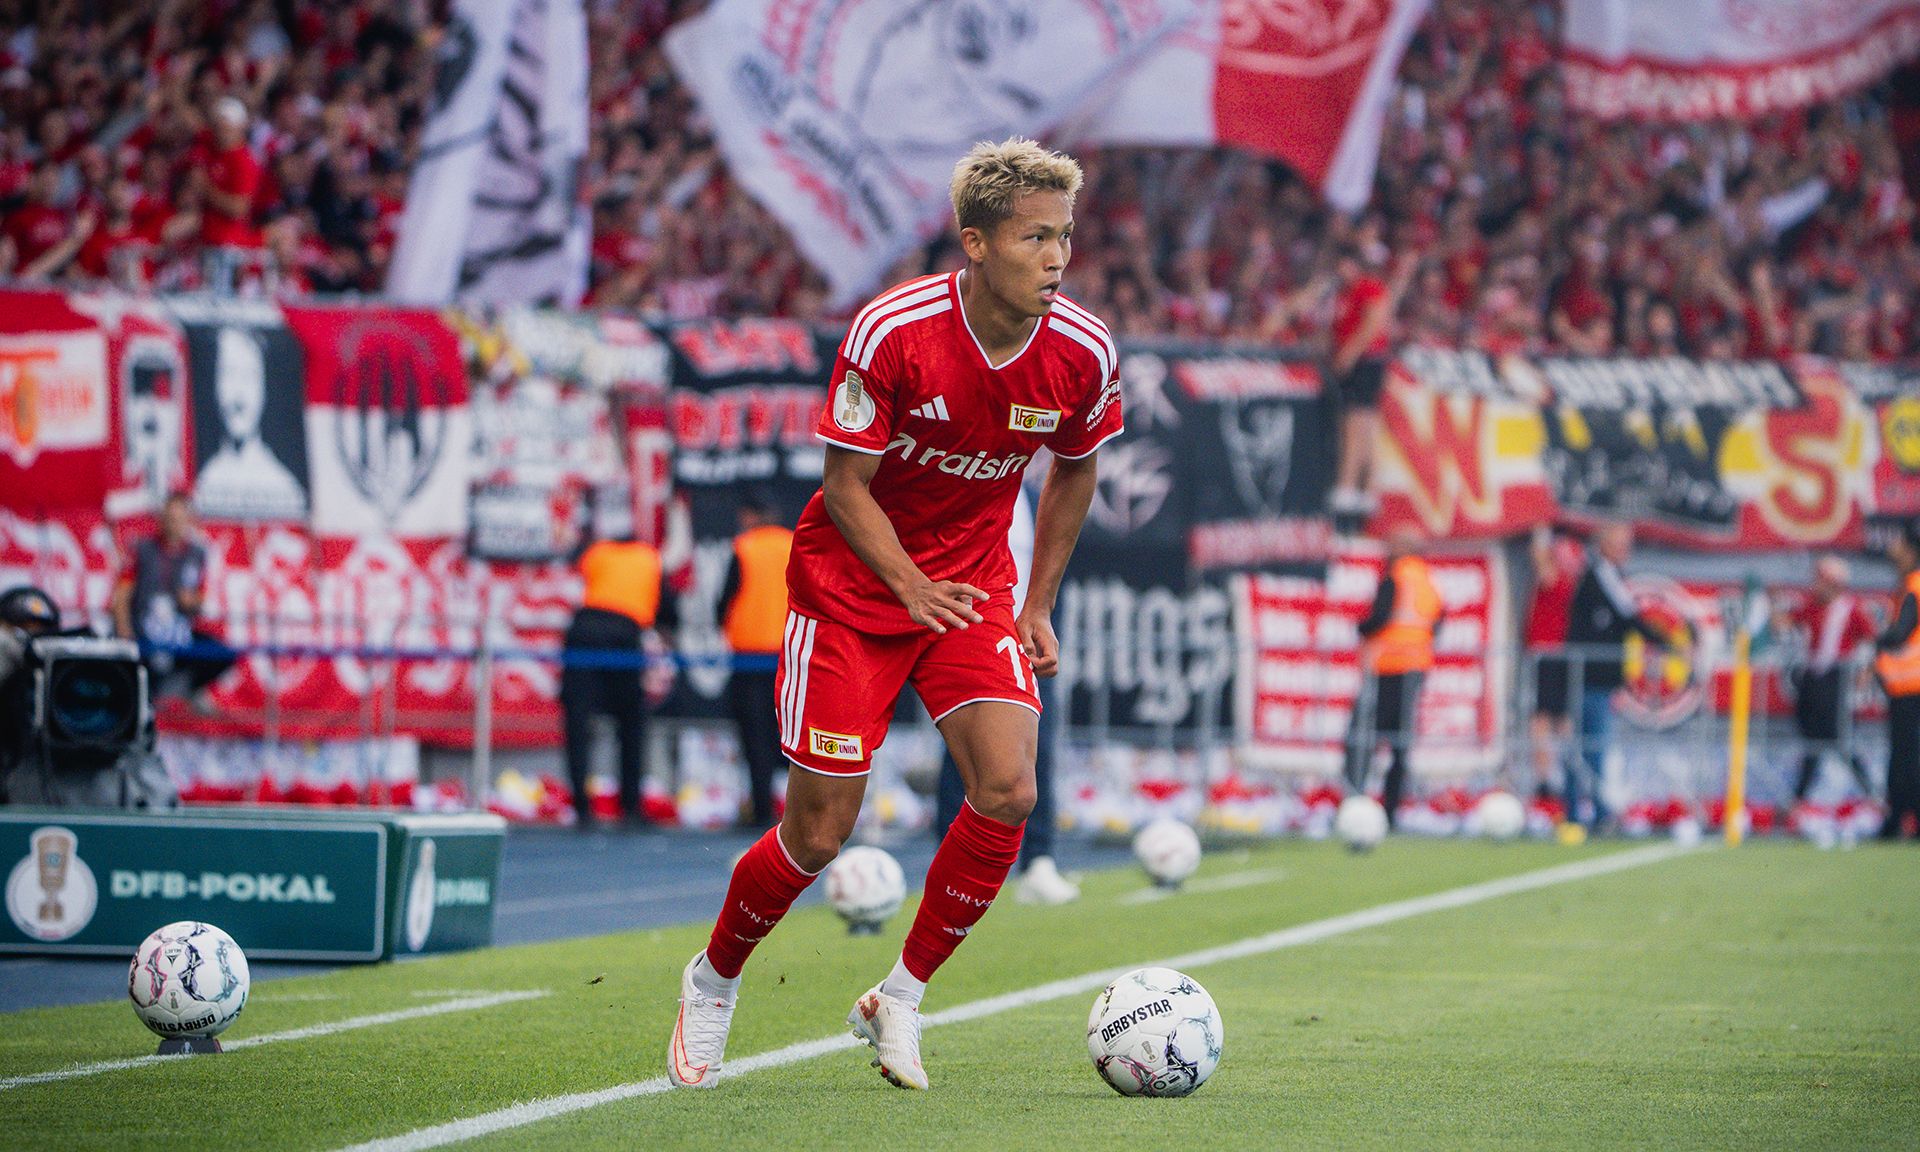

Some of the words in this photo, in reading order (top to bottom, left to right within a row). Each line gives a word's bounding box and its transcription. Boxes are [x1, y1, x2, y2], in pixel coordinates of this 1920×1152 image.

[918, 447, 1029, 481] raisin
[1375, 383, 1498, 533] W
[1760, 374, 1853, 540] S
[838, 744, 858, 755] UNION
[111, 869, 336, 904] DFB-POKAL
[147, 1013, 217, 1033] DERBYSTAR
[1101, 999, 1173, 1043] DERBYSTAR
